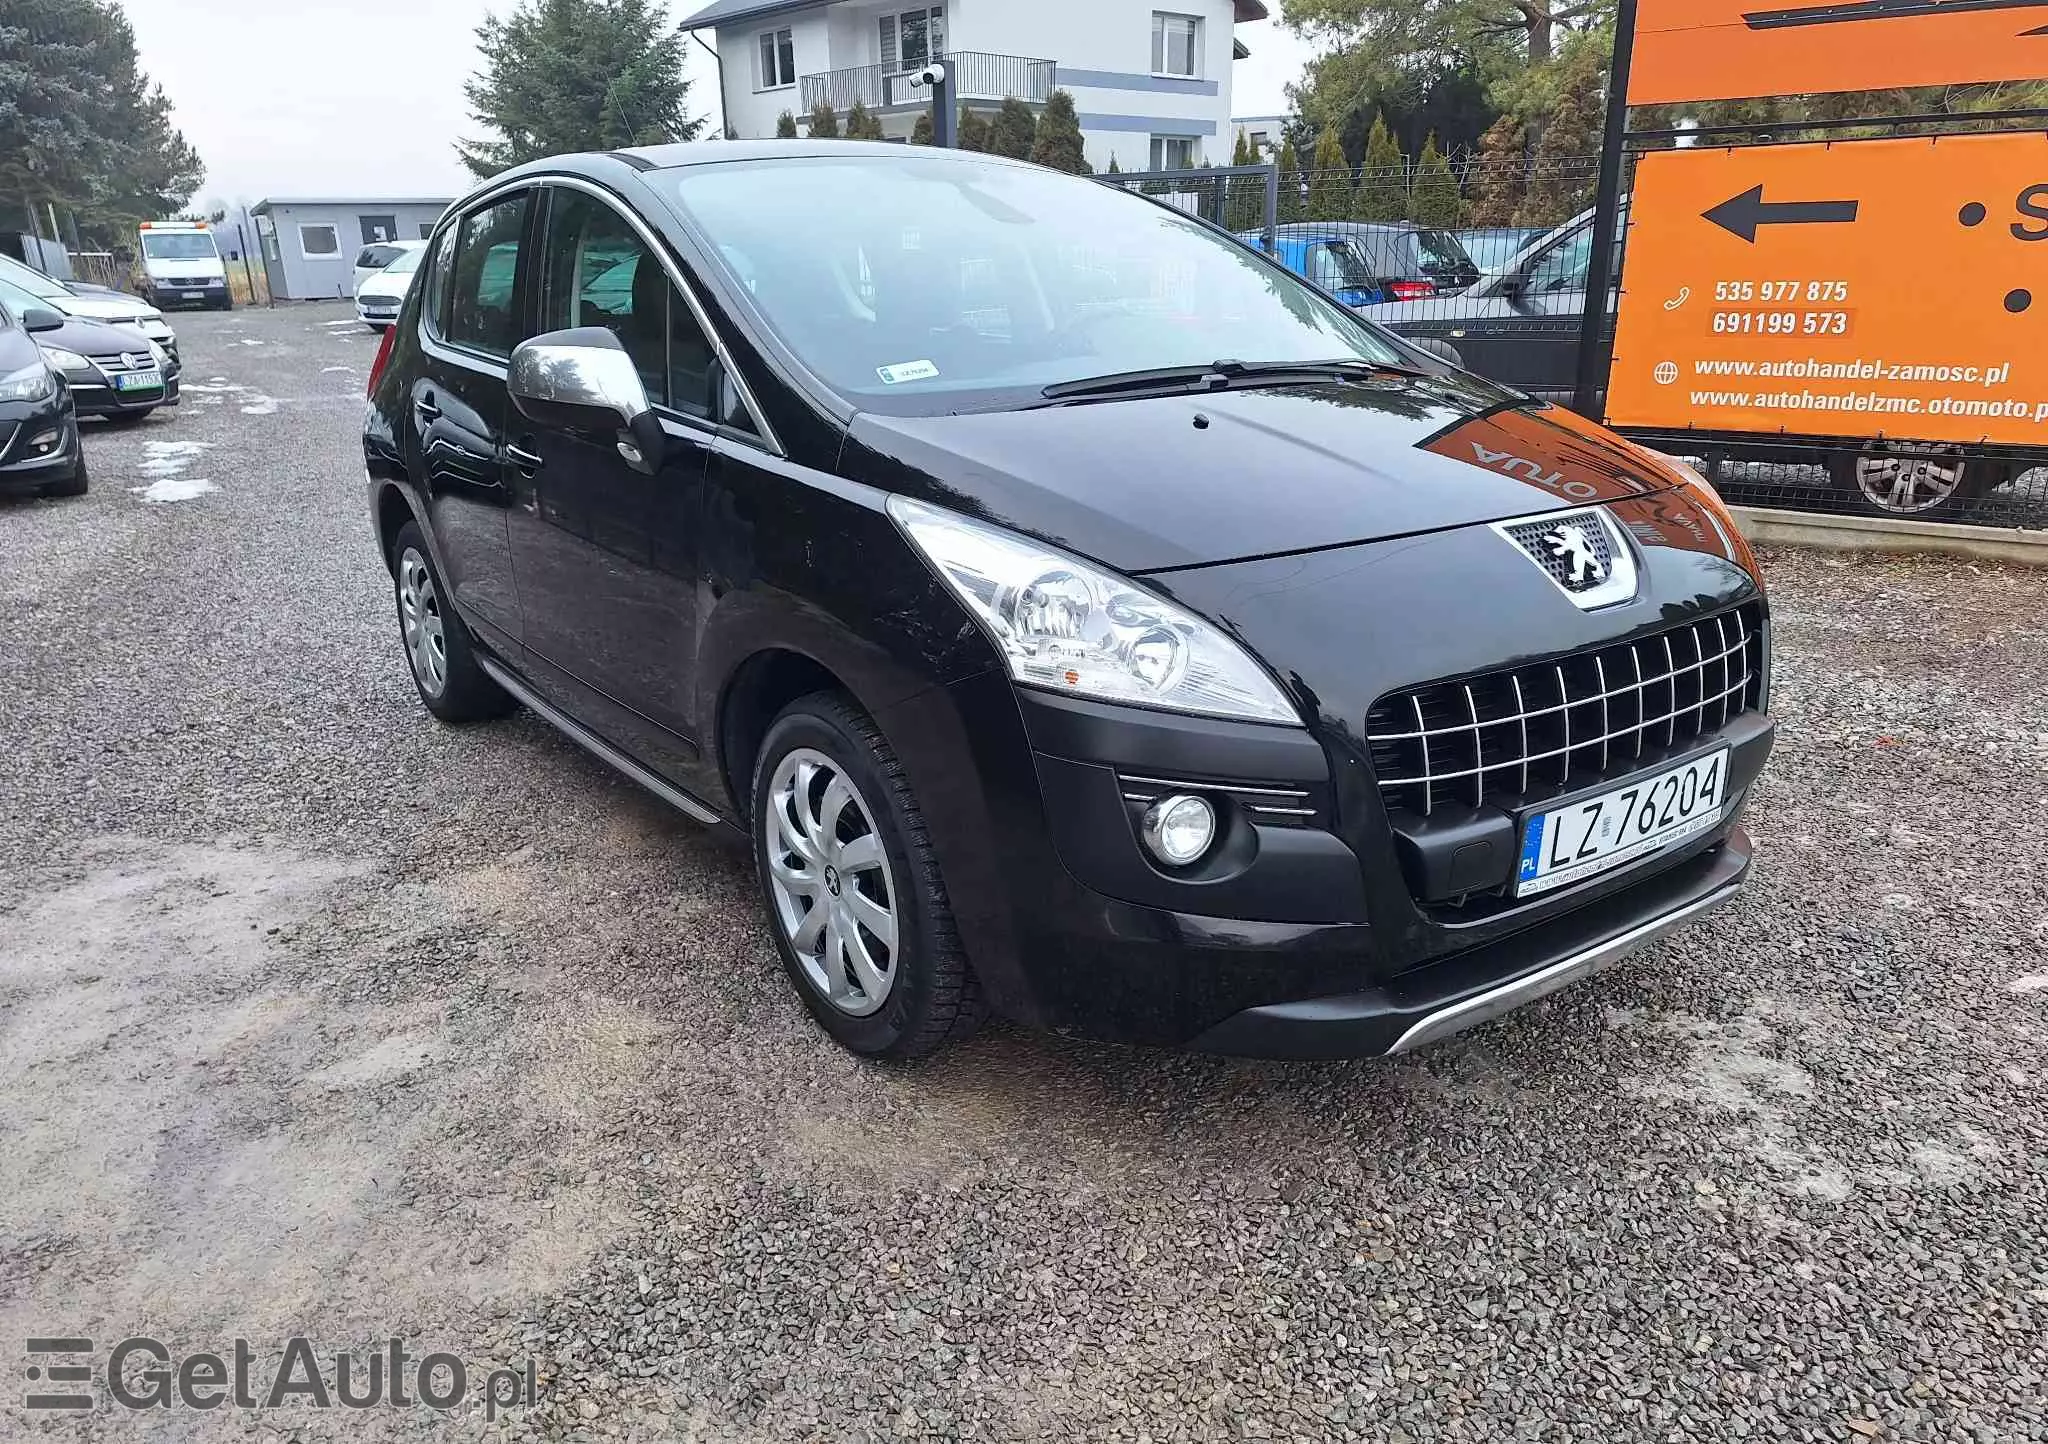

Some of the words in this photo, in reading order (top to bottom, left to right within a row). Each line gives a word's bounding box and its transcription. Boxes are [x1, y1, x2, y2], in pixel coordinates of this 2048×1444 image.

[1715, 281, 1753, 301] 535
[1760, 281, 1800, 301] 977
[1806, 281, 1848, 302] 875
[1803, 312, 1847, 334] 573
[1695, 357, 2010, 387] www.autohandel-zamosc.pl
[1550, 802, 1603, 868] LZ
[1615, 757, 1720, 845] 76204
[1521, 855, 1536, 874] PL
